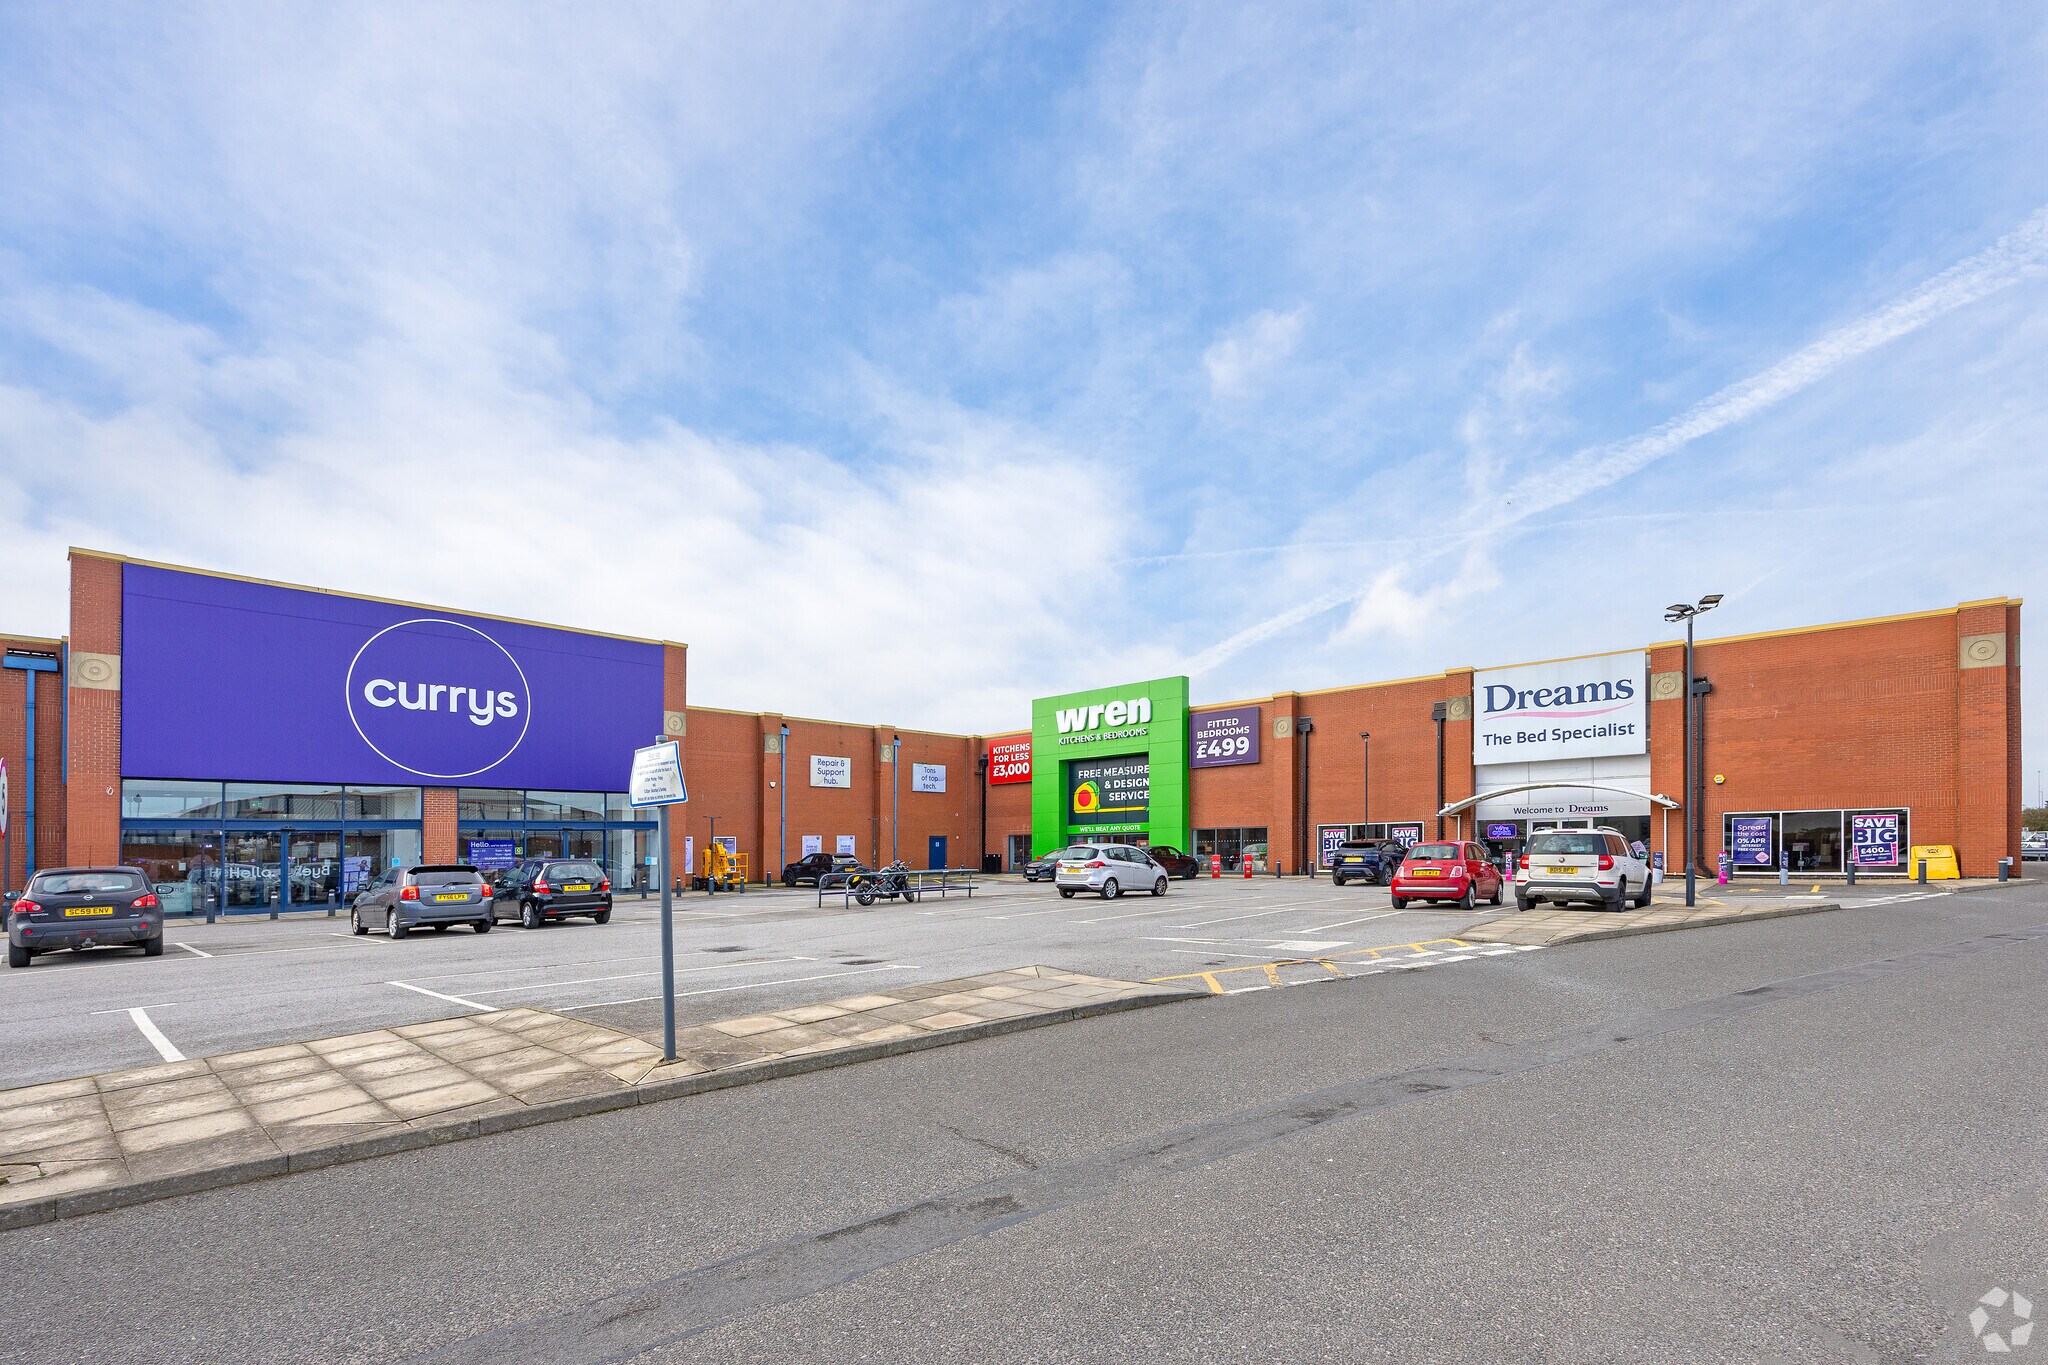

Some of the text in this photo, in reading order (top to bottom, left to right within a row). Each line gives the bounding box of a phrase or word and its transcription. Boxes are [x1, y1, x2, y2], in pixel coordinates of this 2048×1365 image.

[1483, 678, 1635, 714] Dreams
[364, 678, 518, 726] currys
[1055, 697, 1152, 734] wren
[1207, 718, 1239, 729] FITTED
[1058, 734, 1095, 745] KITCHENS
[1104, 728, 1148, 740] BEDROOMS
[1197, 725, 1250, 739] BEDROOMS
[1483, 722, 1635, 746] The Bed Specialist
[993, 743, 1030, 754] KITCHENS
[1196, 736, 1250, 759] £499
[817, 758, 845, 768] Repair &
[994, 752, 1029, 763] FOR LESS
[817, 767, 845, 776] Support
[924, 766, 936, 774] Tons
[993, 762, 1030, 778] £3,000
[1078, 764, 1149, 779] FREE MEASURE
[823, 776, 838, 785] hub.
[928, 775, 939, 783] top
[1104, 778, 1149, 789] & DESIGN
[923, 782, 937, 790] tech.
[1108, 790, 1149, 801] SERVICE
[1513, 804, 1609, 815] Welcome to Dreams
[1737, 824, 1766, 832] Spread
[1854, 818, 1895, 828] SAVE
[1393, 830, 1417, 838] SAVE
[1854, 828, 1897, 843] BIG
[69, 908, 91, 916] SC59
